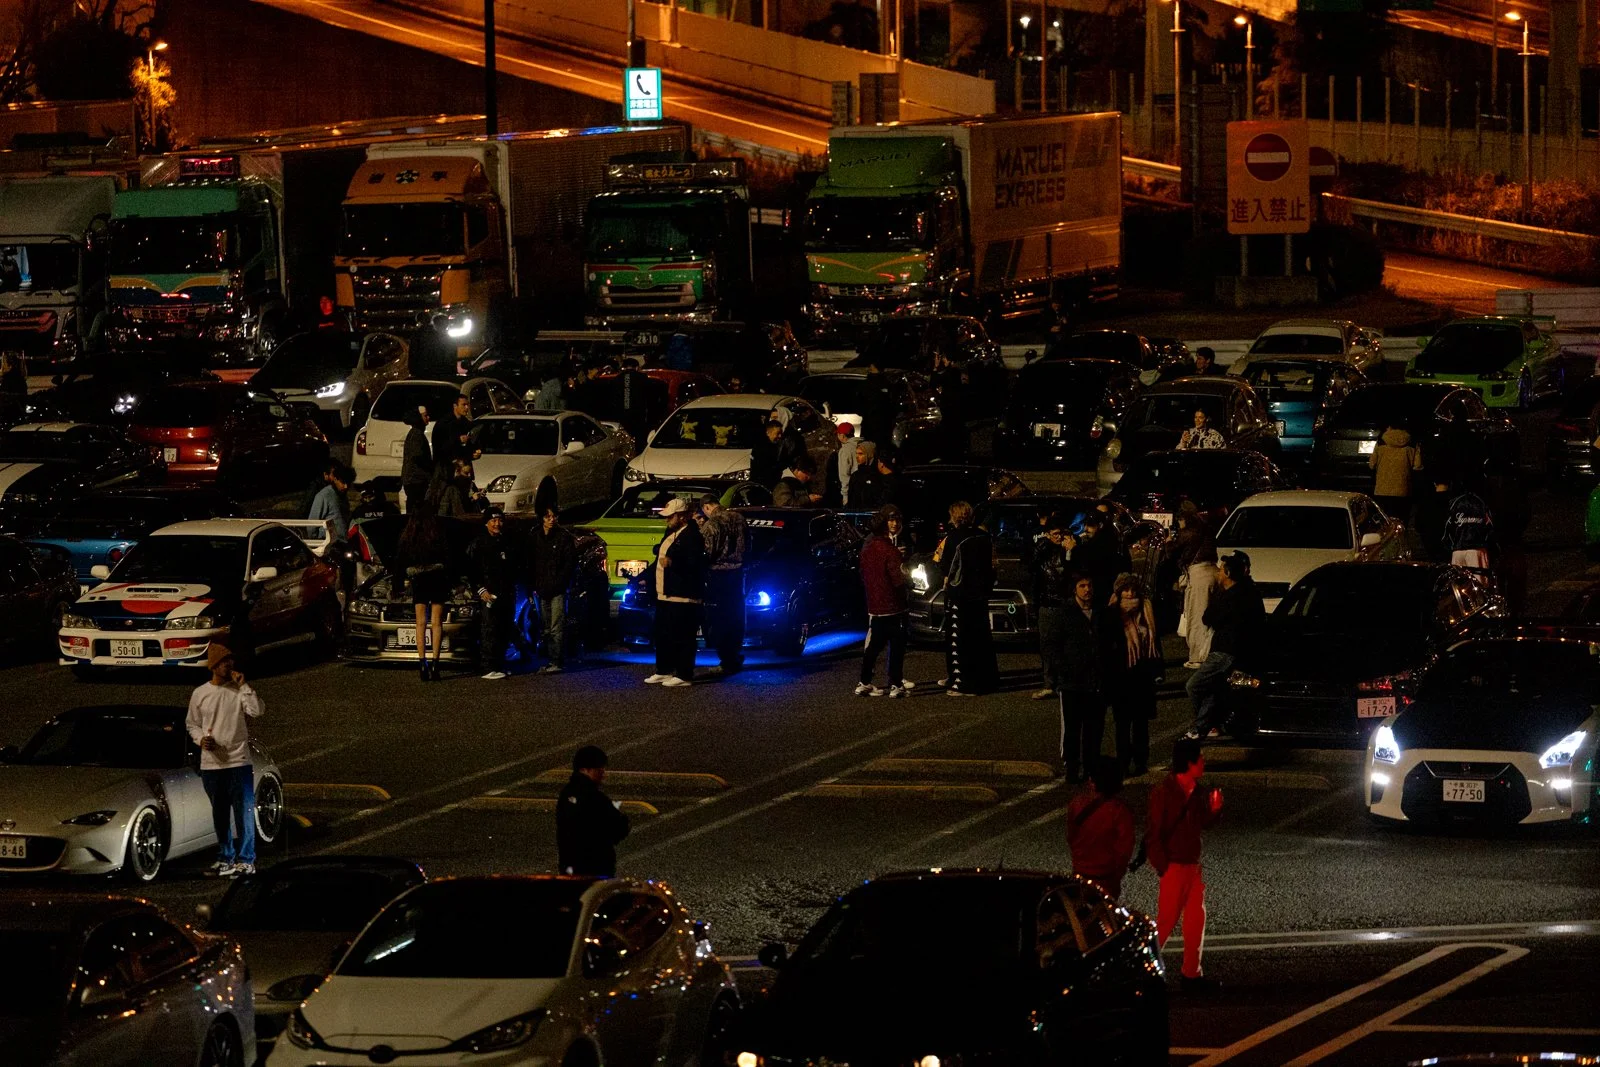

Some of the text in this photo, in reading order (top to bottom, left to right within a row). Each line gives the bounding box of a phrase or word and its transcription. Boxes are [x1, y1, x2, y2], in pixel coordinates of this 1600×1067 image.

[996, 143, 1067, 178] MARUEI
[994, 177, 1066, 209] EXPRESS
[1231, 196, 1306, 223] 進入禁止
[117, 646, 141, 656] 50-01
[1367, 705, 1395, 716] 17-24
[1452, 788, 1483, 801] 77-50
